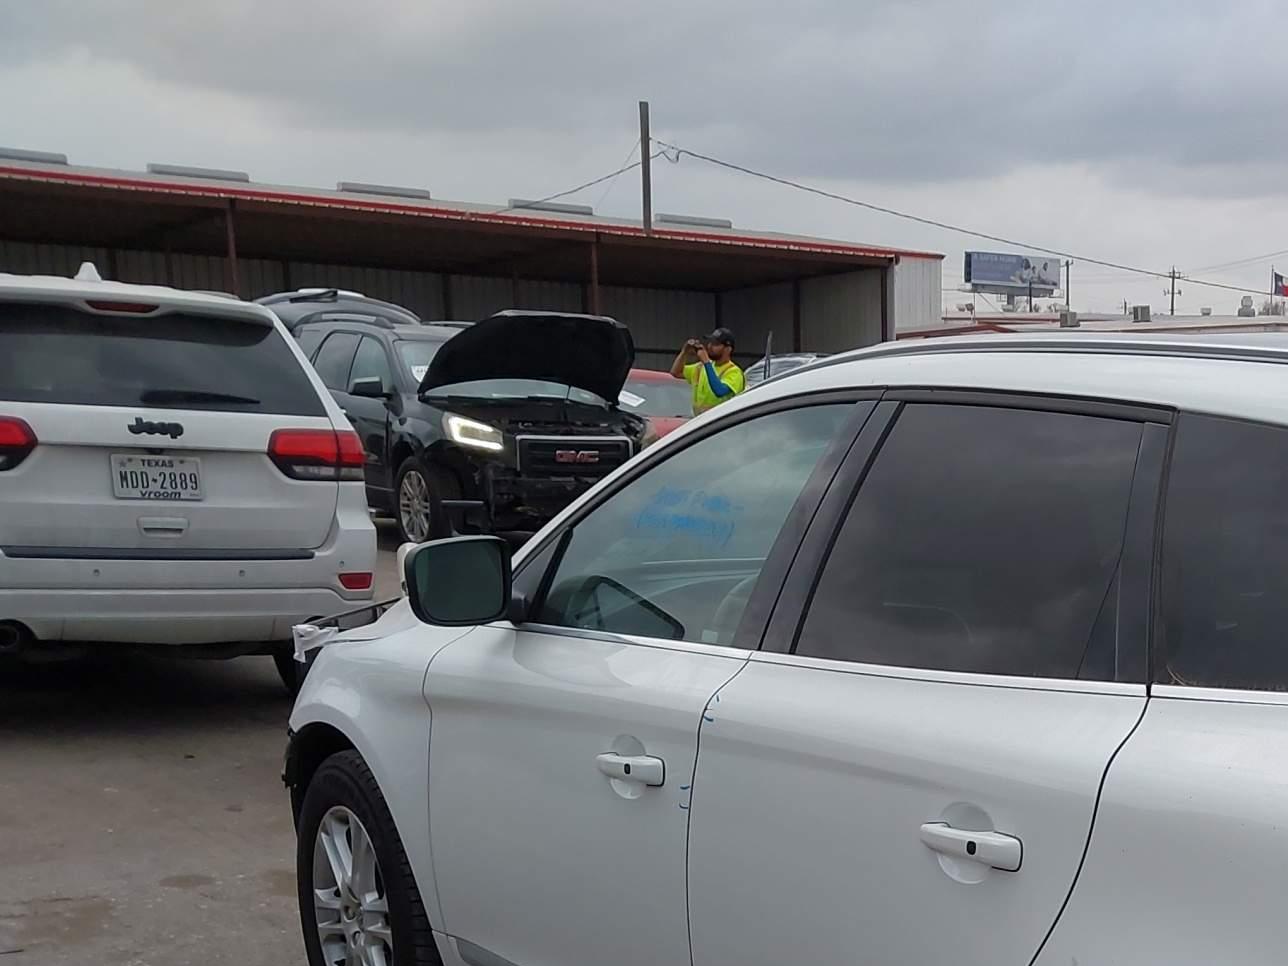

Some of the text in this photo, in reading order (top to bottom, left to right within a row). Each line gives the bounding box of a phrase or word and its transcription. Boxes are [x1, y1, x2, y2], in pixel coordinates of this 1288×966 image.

[127, 416, 184, 440] Jeep
[555, 449, 600, 463] GMC
[141, 458, 174, 468] TEXAS
[140, 490, 181, 499] vroom
